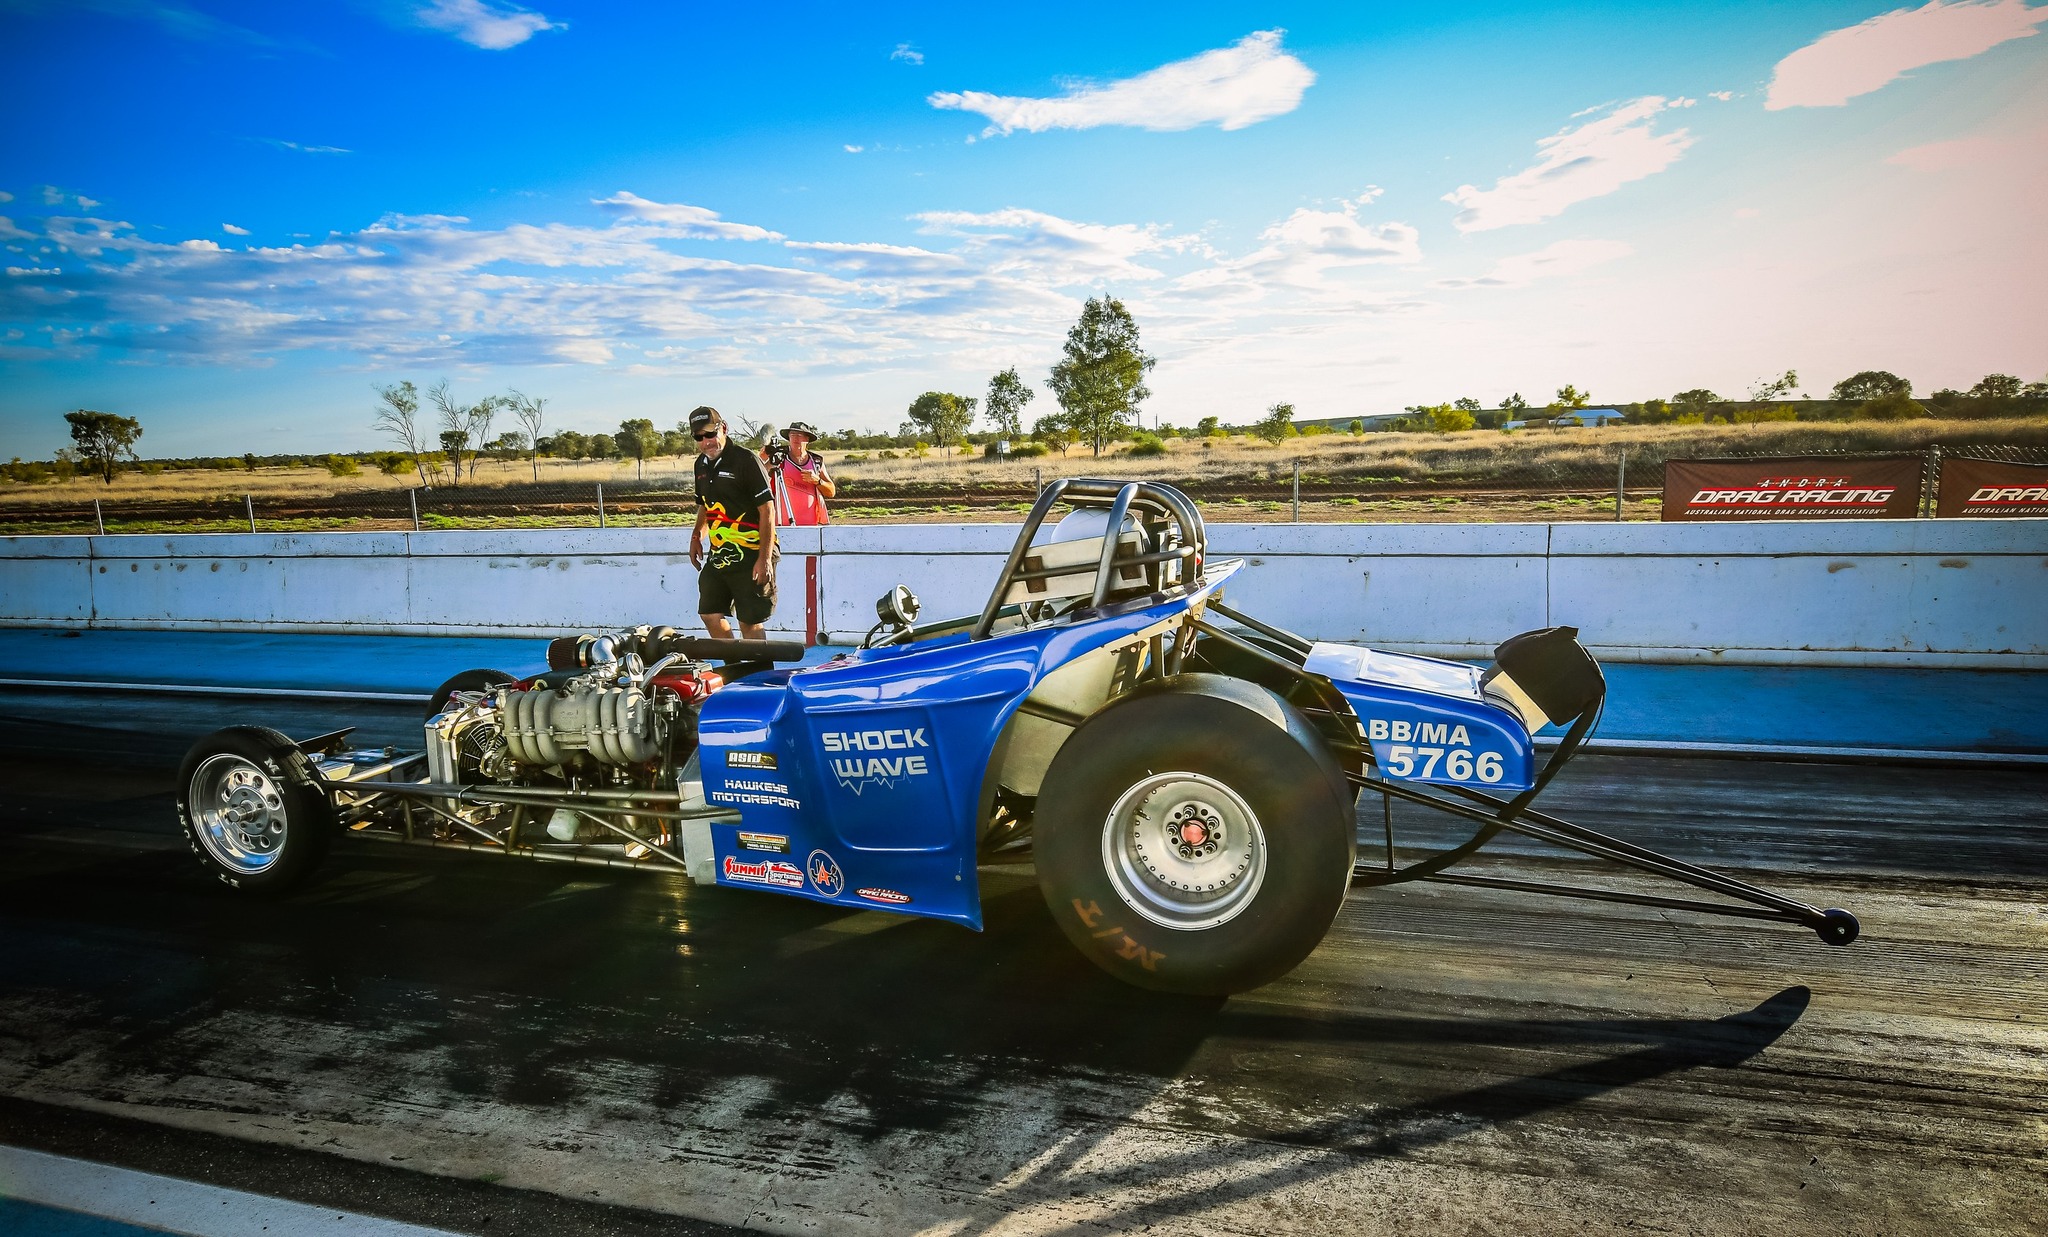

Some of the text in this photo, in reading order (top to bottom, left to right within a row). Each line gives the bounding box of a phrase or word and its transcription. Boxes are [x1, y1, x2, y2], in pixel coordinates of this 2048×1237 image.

[1689, 489, 1895, 503] DRAG RACING
[822, 728, 930, 752] SHOCK
[1369, 719, 1471, 746] BB/MA
[835, 755, 929, 777] WAVE
[1387, 745, 1504, 783] 5766
[724, 779, 789, 795] HAWKEYE
[712, 791, 800, 810] MOTORSPORT
[858, 888, 880, 896] DRAG
